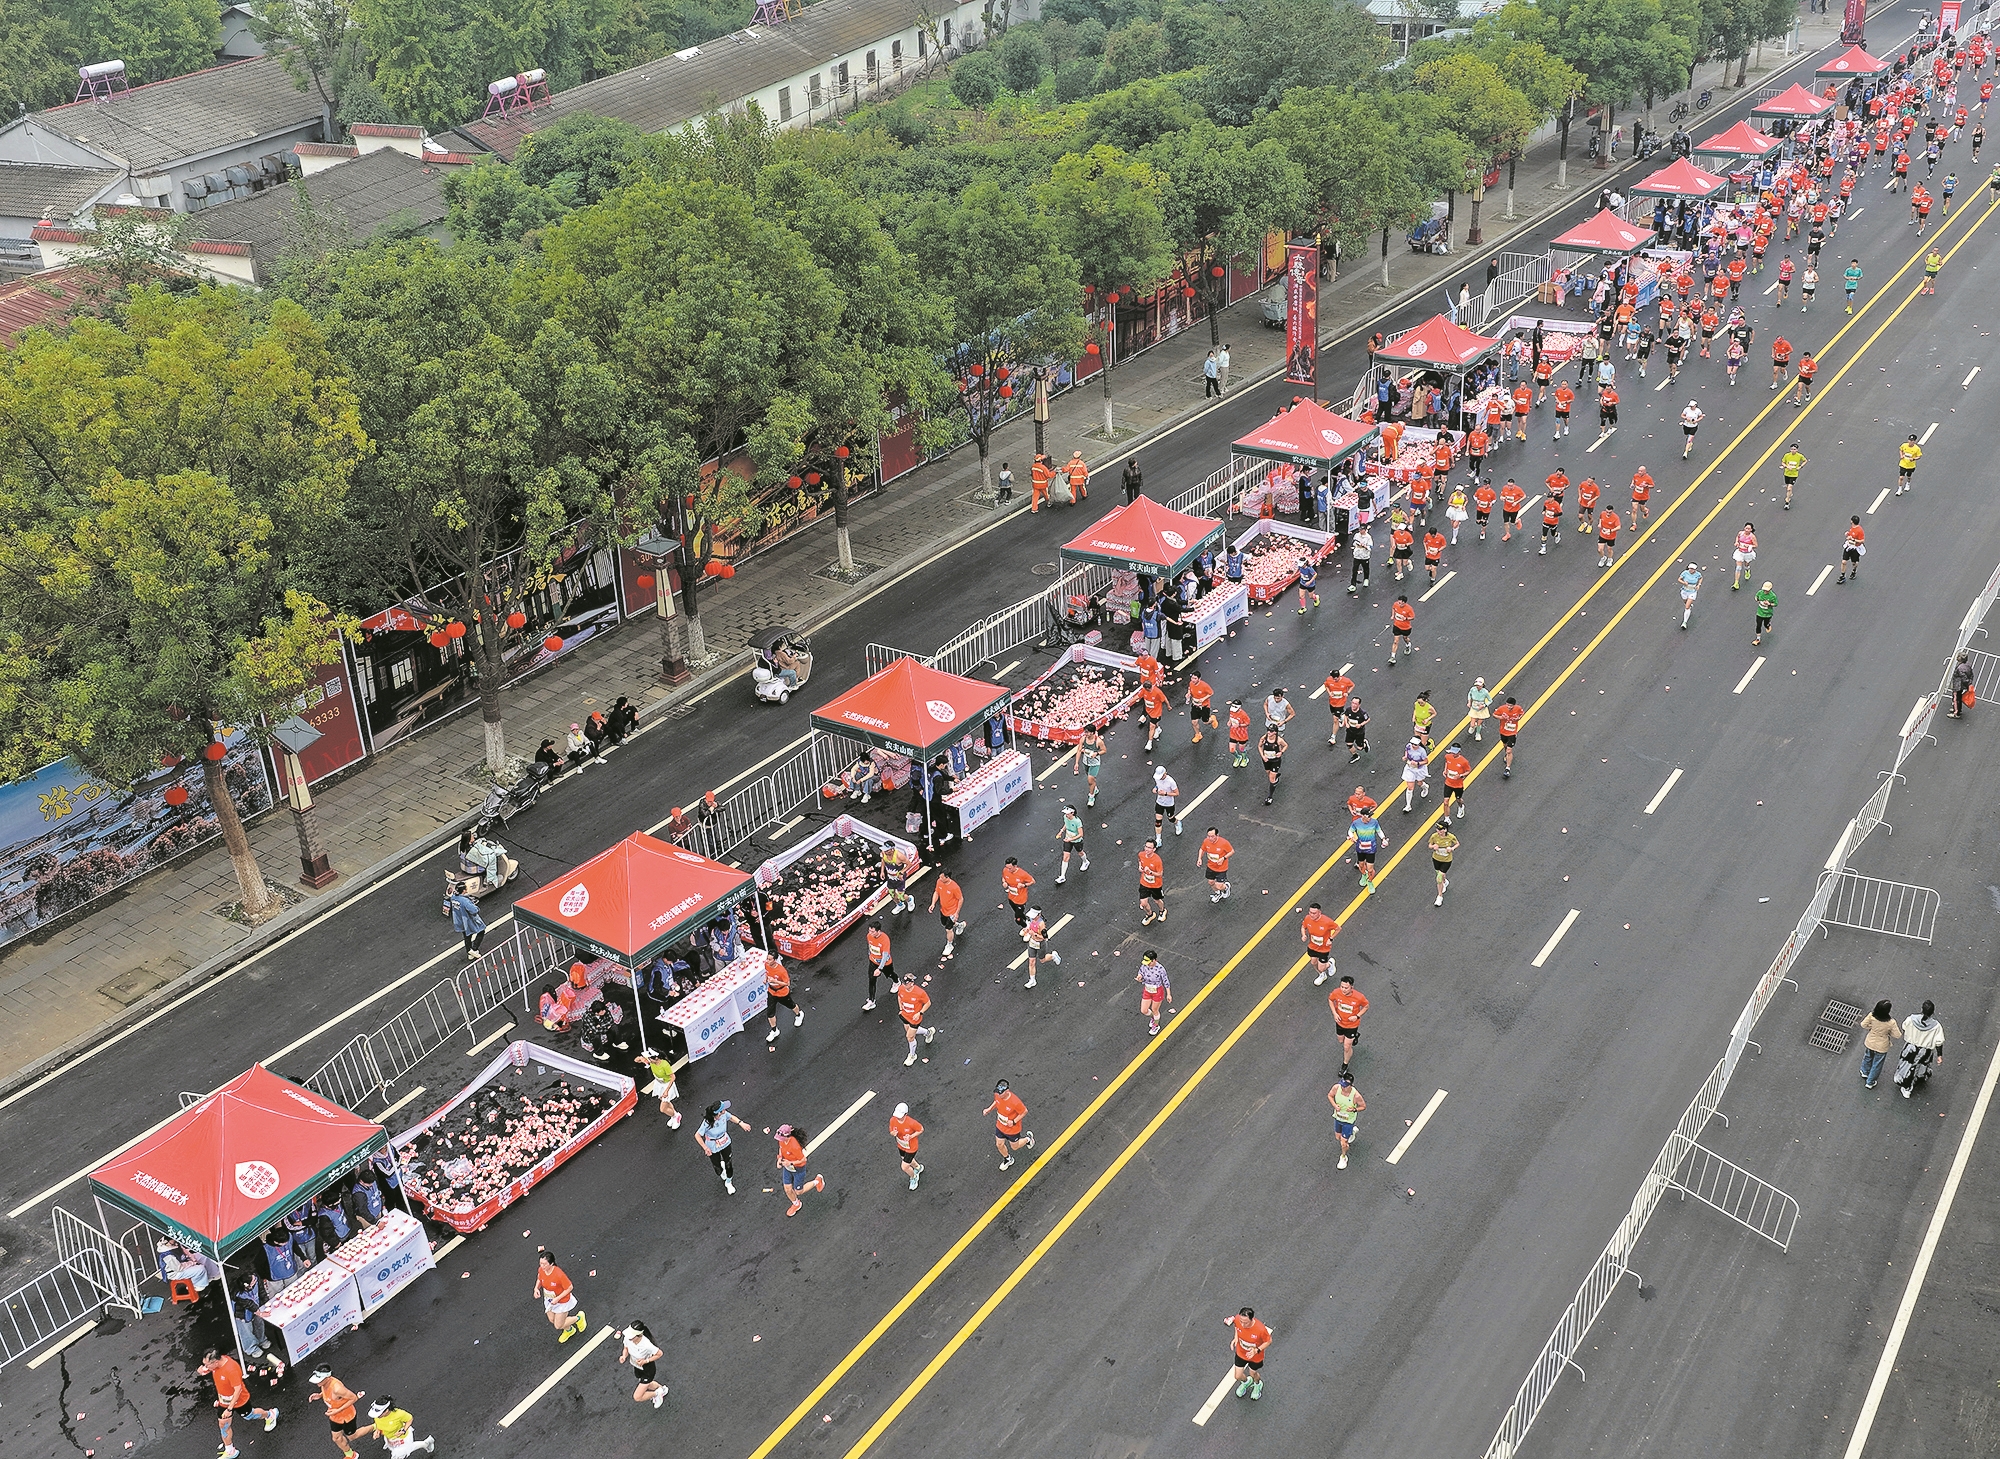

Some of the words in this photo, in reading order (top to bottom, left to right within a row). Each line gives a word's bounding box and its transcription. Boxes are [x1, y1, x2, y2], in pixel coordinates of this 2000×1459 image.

[1128, 561, 1159, 575] 农夫山泉
[840, 710, 891, 731] 天然的弱碱性水
[884, 740, 914, 757] 农夫山泉
[647, 892, 704, 931] 天然的弱碱性水
[710, 1016, 726, 1033] 饮水
[129, 1169, 190, 1207] 天然的弱碱性水
[391, 1252, 413, 1273] 饮水
[319, 1303, 342, 1325] 饮水
